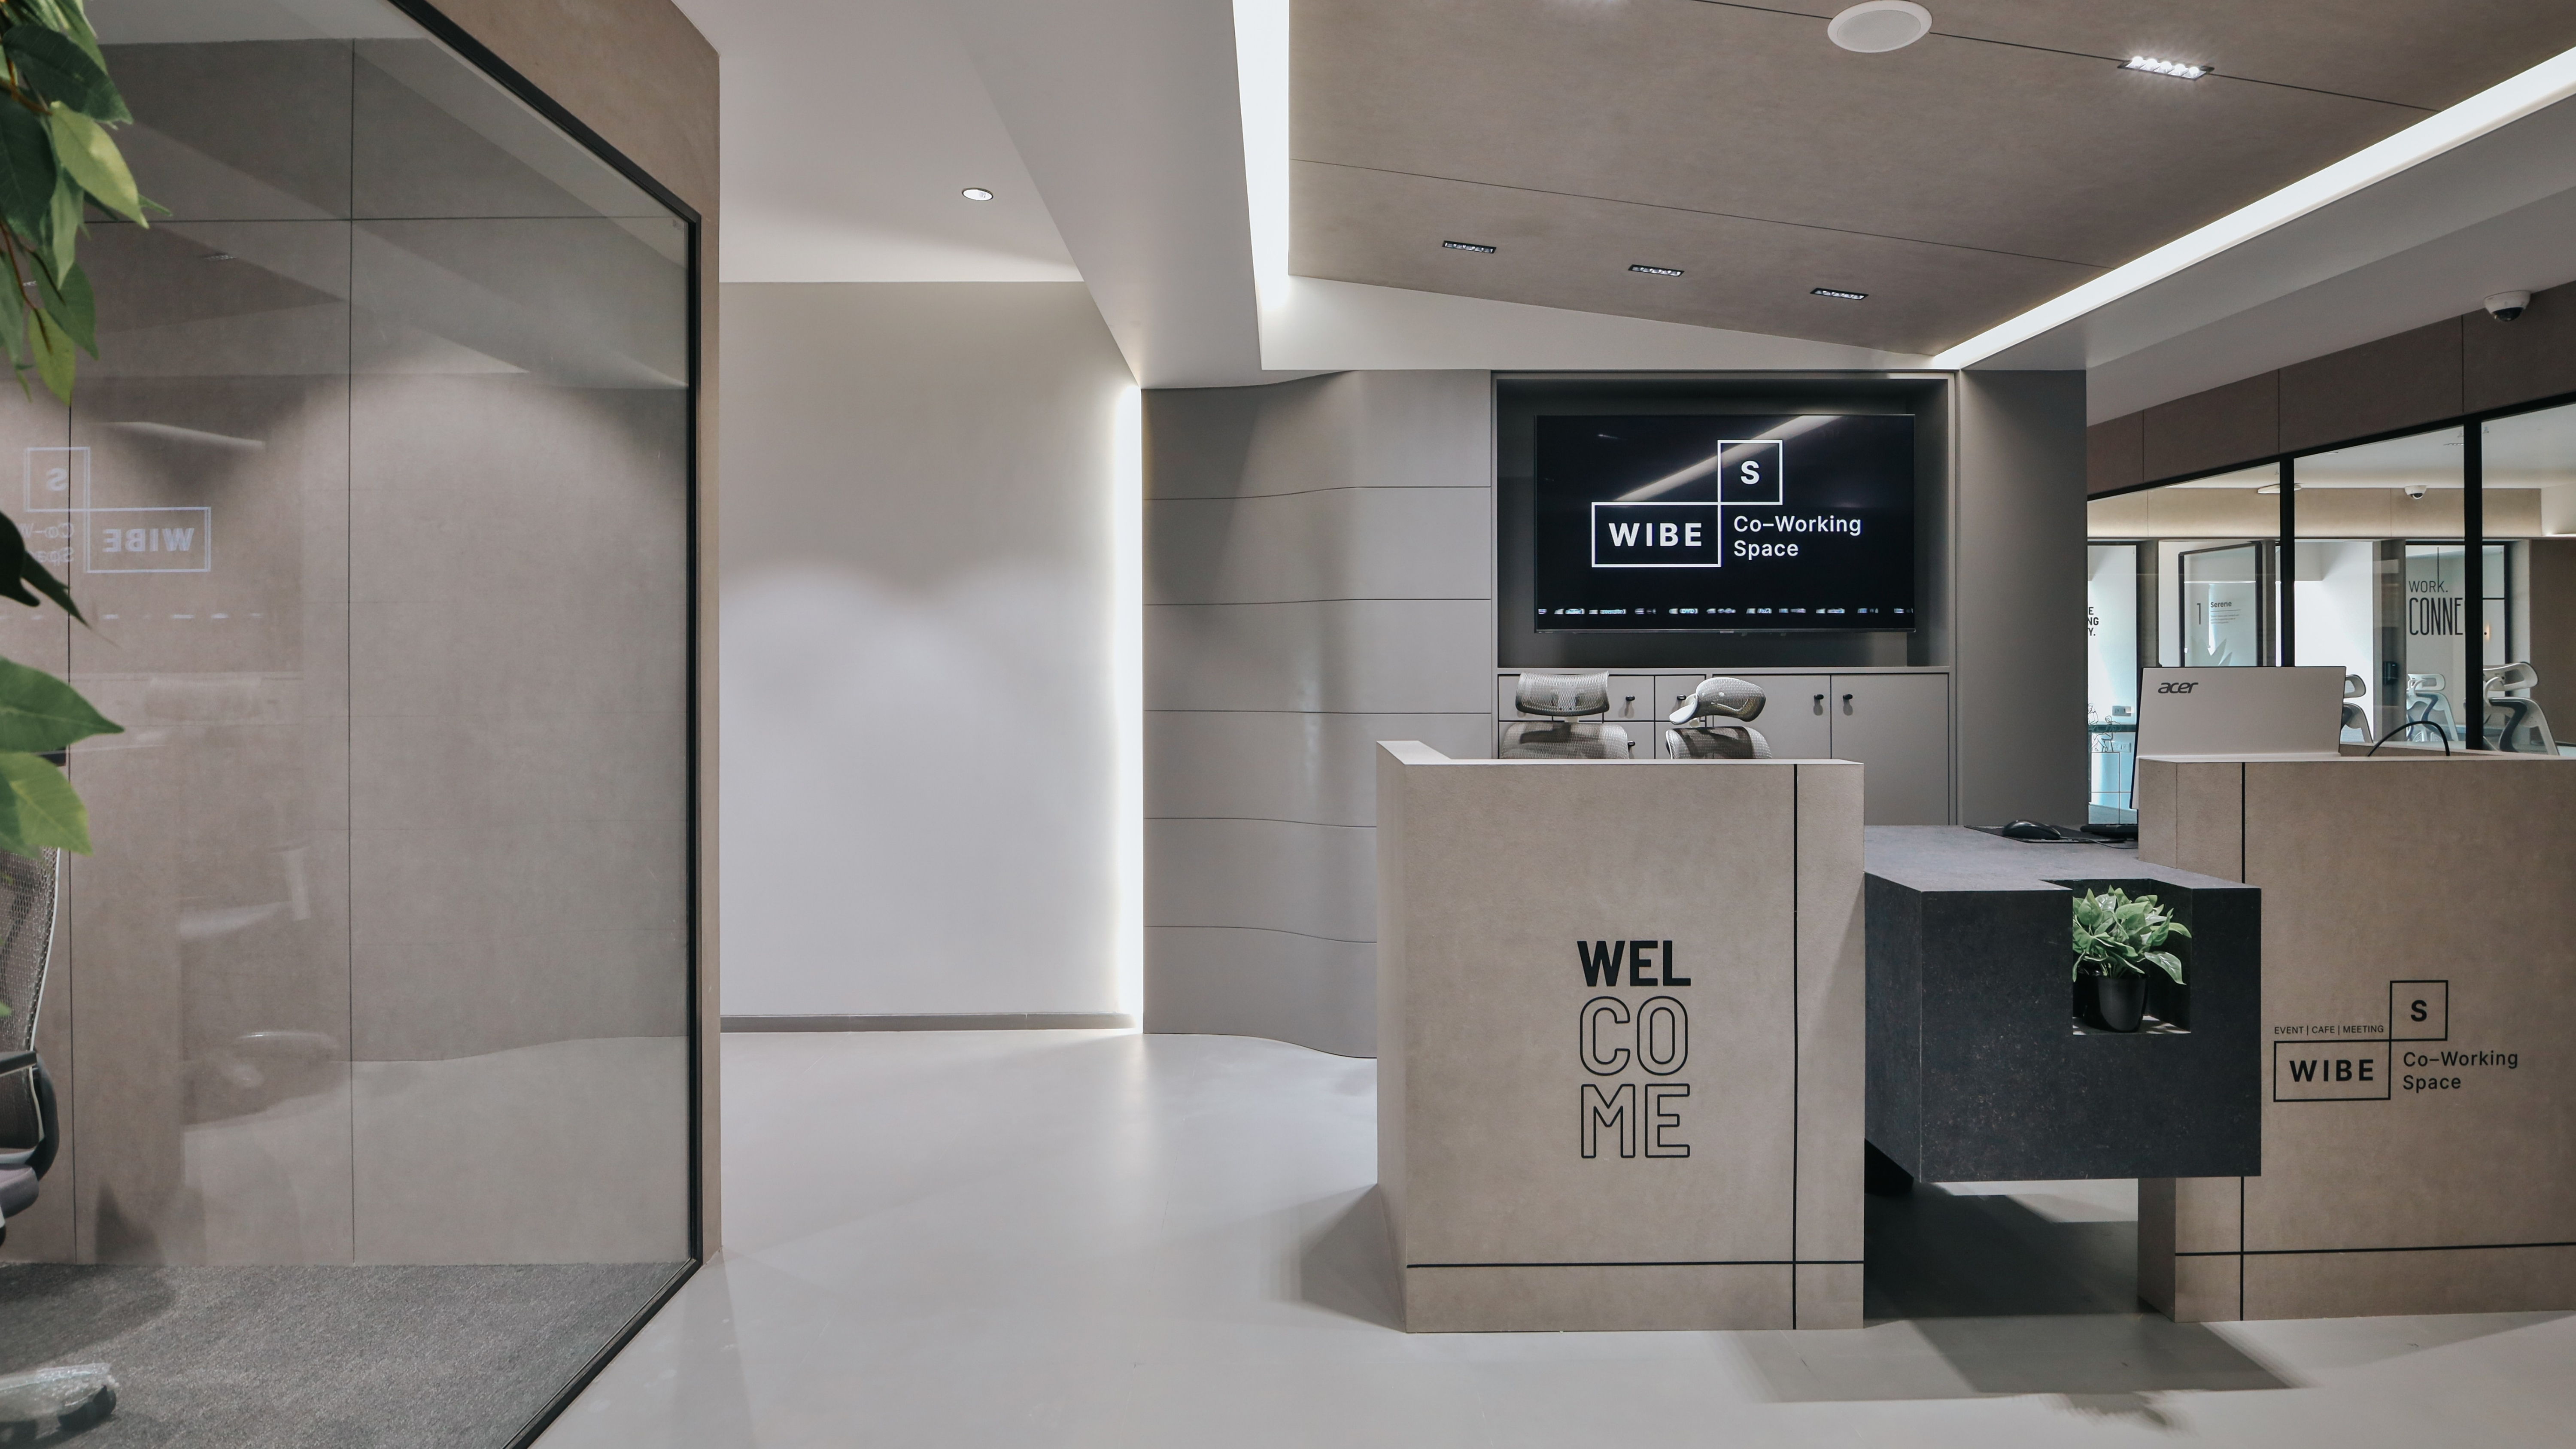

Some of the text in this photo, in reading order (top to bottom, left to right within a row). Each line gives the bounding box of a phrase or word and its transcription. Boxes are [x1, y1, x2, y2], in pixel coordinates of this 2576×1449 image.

[1741, 460, 1760, 485] S
[1608, 522, 1702, 547] WIBE
[1734, 540, 1799, 560] Space
[2409, 580, 2448, 593] WORK.
[2158, 682, 2199, 694] acer
[1577, 940, 1691, 987] WEL
[2410, 999, 2427, 1022] S
[1580, 996, 1688, 1076] CO
[2274, 1026, 2304, 1034] EVENT
[2312, 1026, 2335, 1034] CAFE
[2343, 1025, 2384, 1033] MEETING
[2289, 1059, 2374, 1082] WIBE
[2403, 1075, 2461, 1094] Space
[1581, 1083, 1690, 1159] ME
